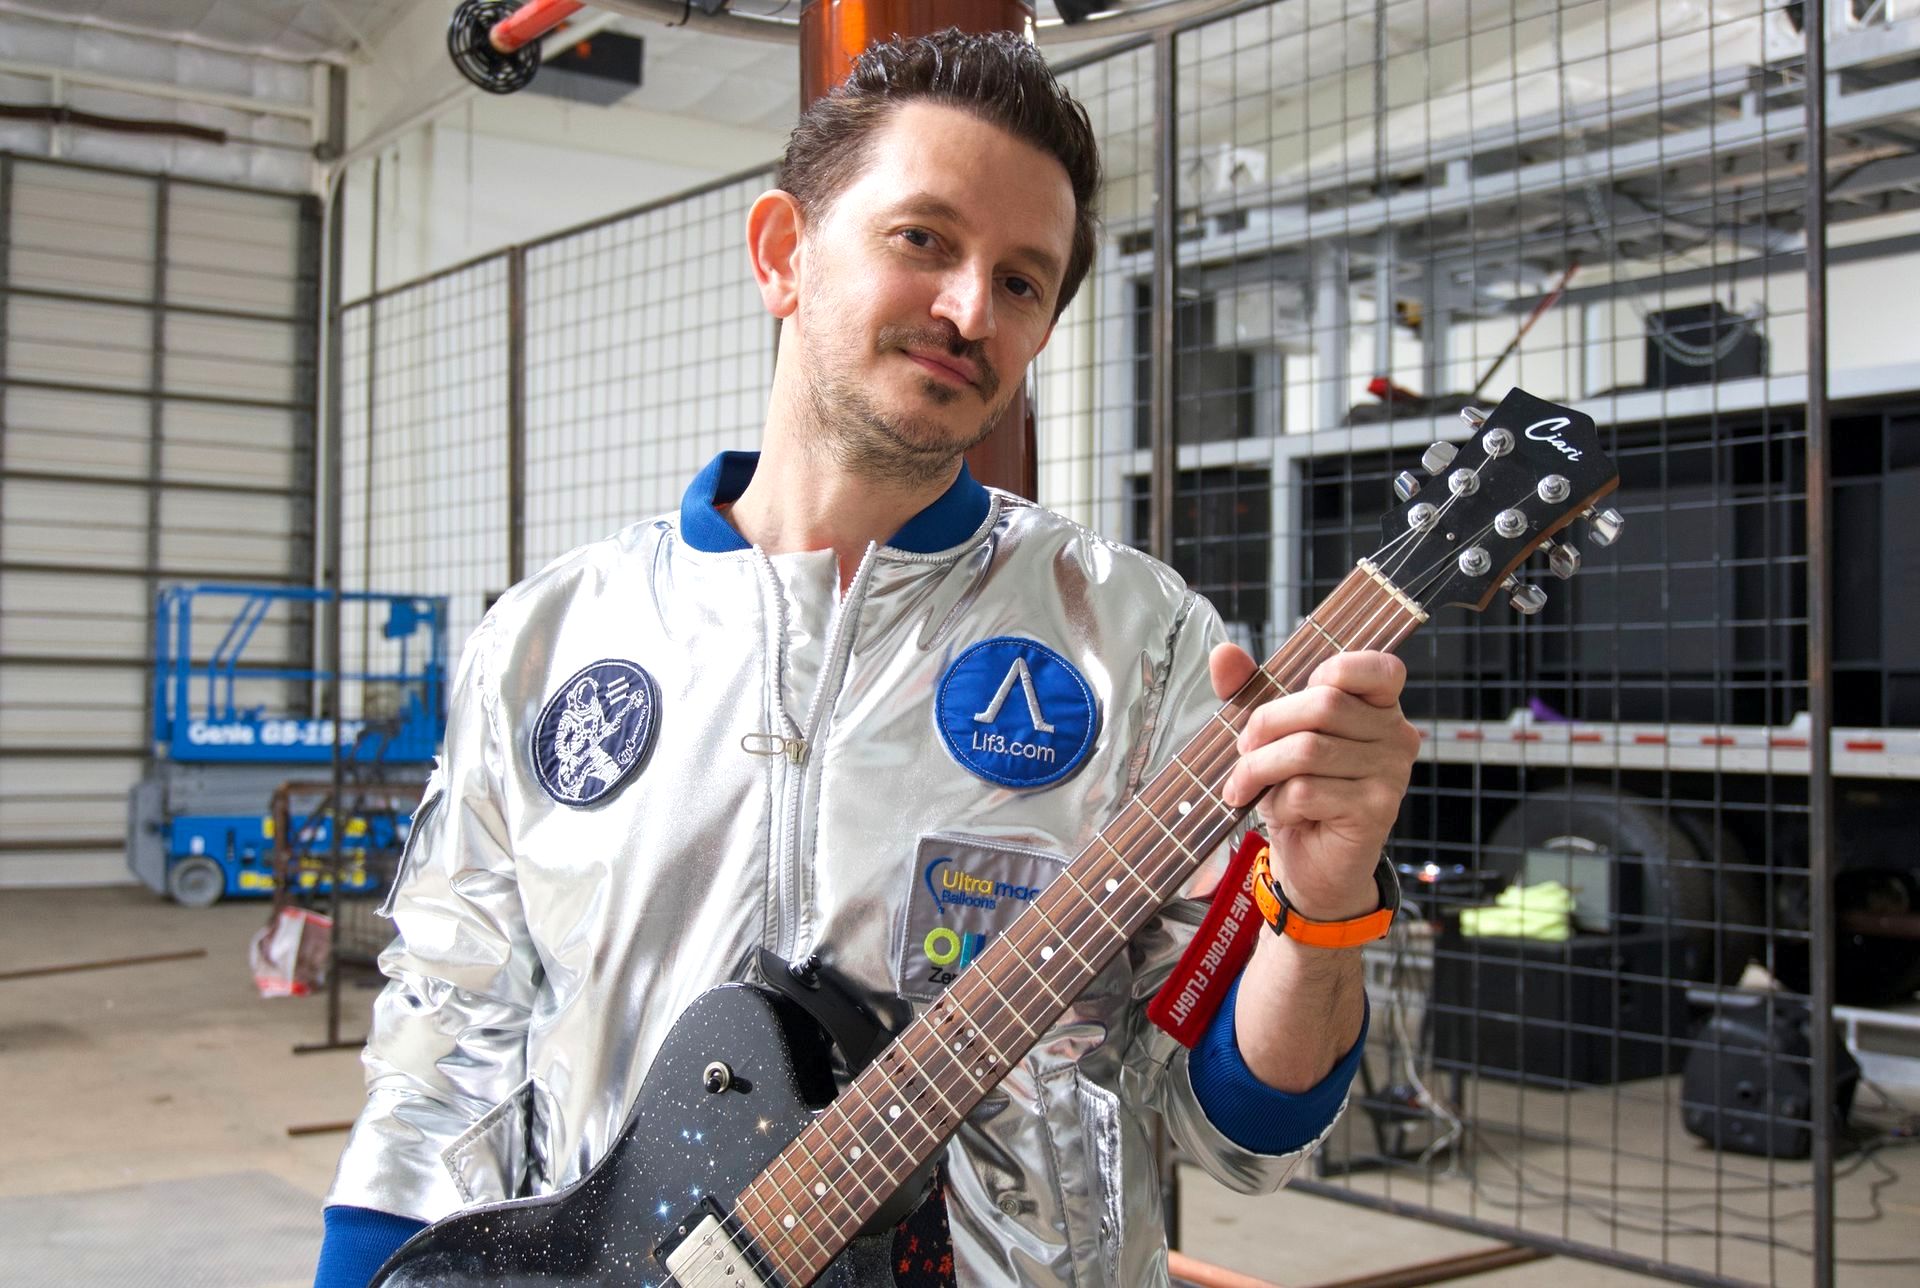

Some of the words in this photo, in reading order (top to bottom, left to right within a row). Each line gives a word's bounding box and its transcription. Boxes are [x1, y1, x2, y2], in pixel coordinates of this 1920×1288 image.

[1524, 416, 1584, 462] Ciari
[972, 731, 1056, 763] Lif3.com
[941, 889, 997, 911] Balloons
[1198, 917, 1241, 977] BEFORE
[1167, 969, 1210, 1027] FLIGHT
